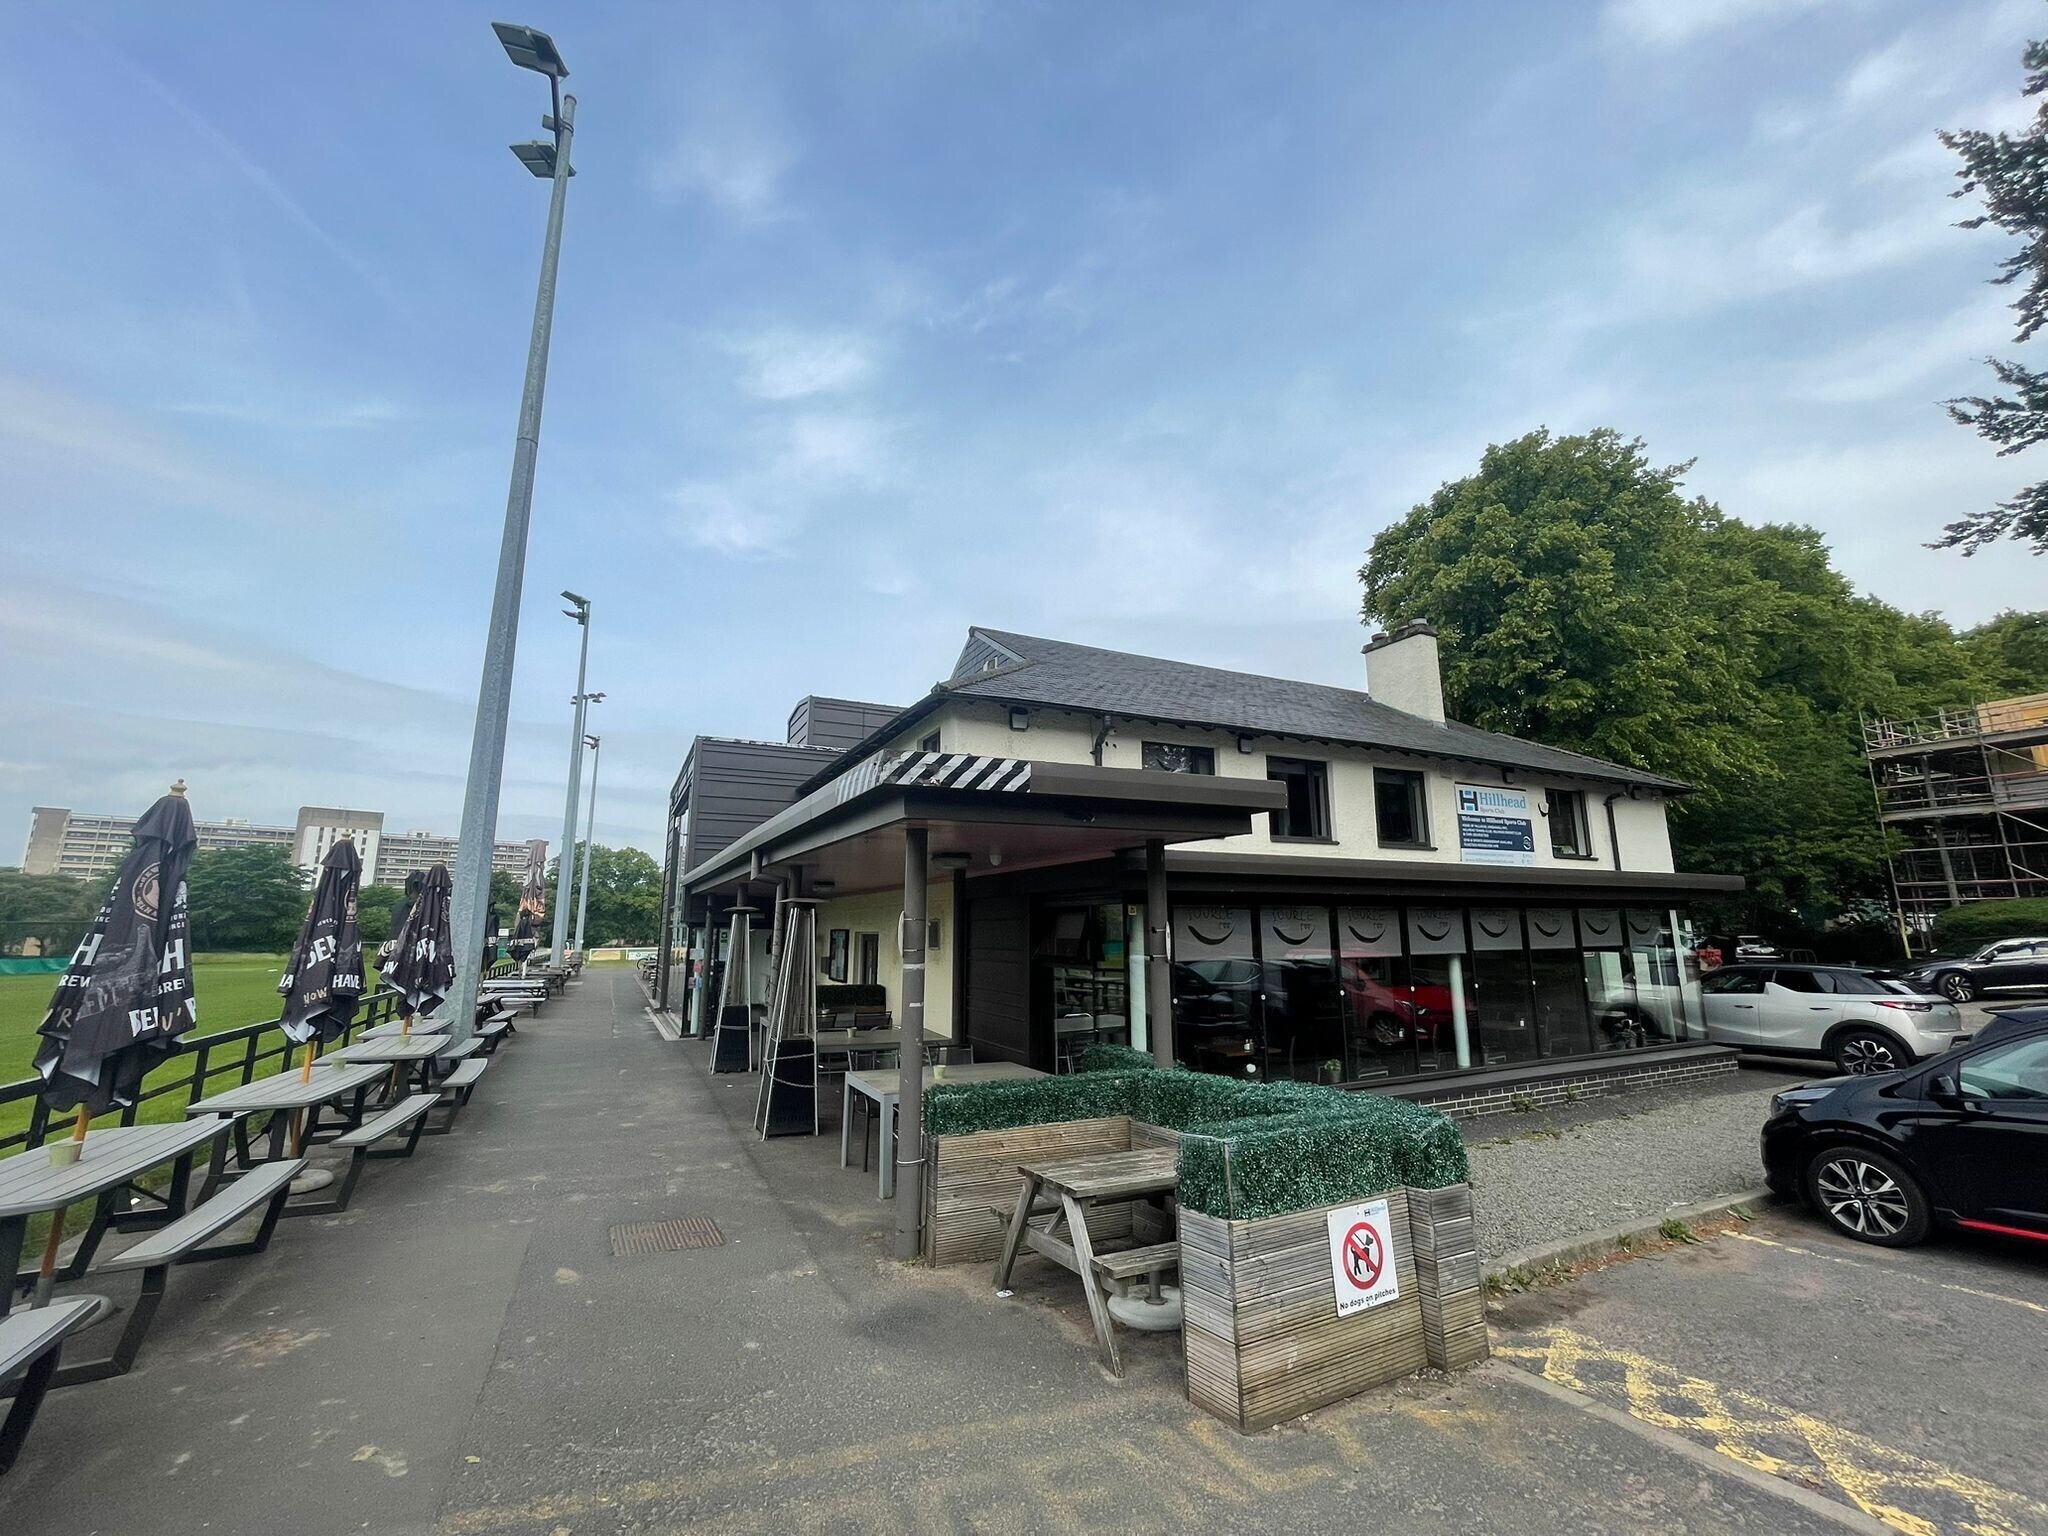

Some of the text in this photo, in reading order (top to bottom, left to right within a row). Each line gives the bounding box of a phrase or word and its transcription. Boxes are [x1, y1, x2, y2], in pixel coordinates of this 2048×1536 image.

[1479, 792, 1527, 809] Hillhead
[332, 973, 361, 989] HAVE
[1340, 1302, 1349, 1310] No
[1350, 1297, 1364, 1307] dogs
[1374, 1288, 1396, 1301] pitches
